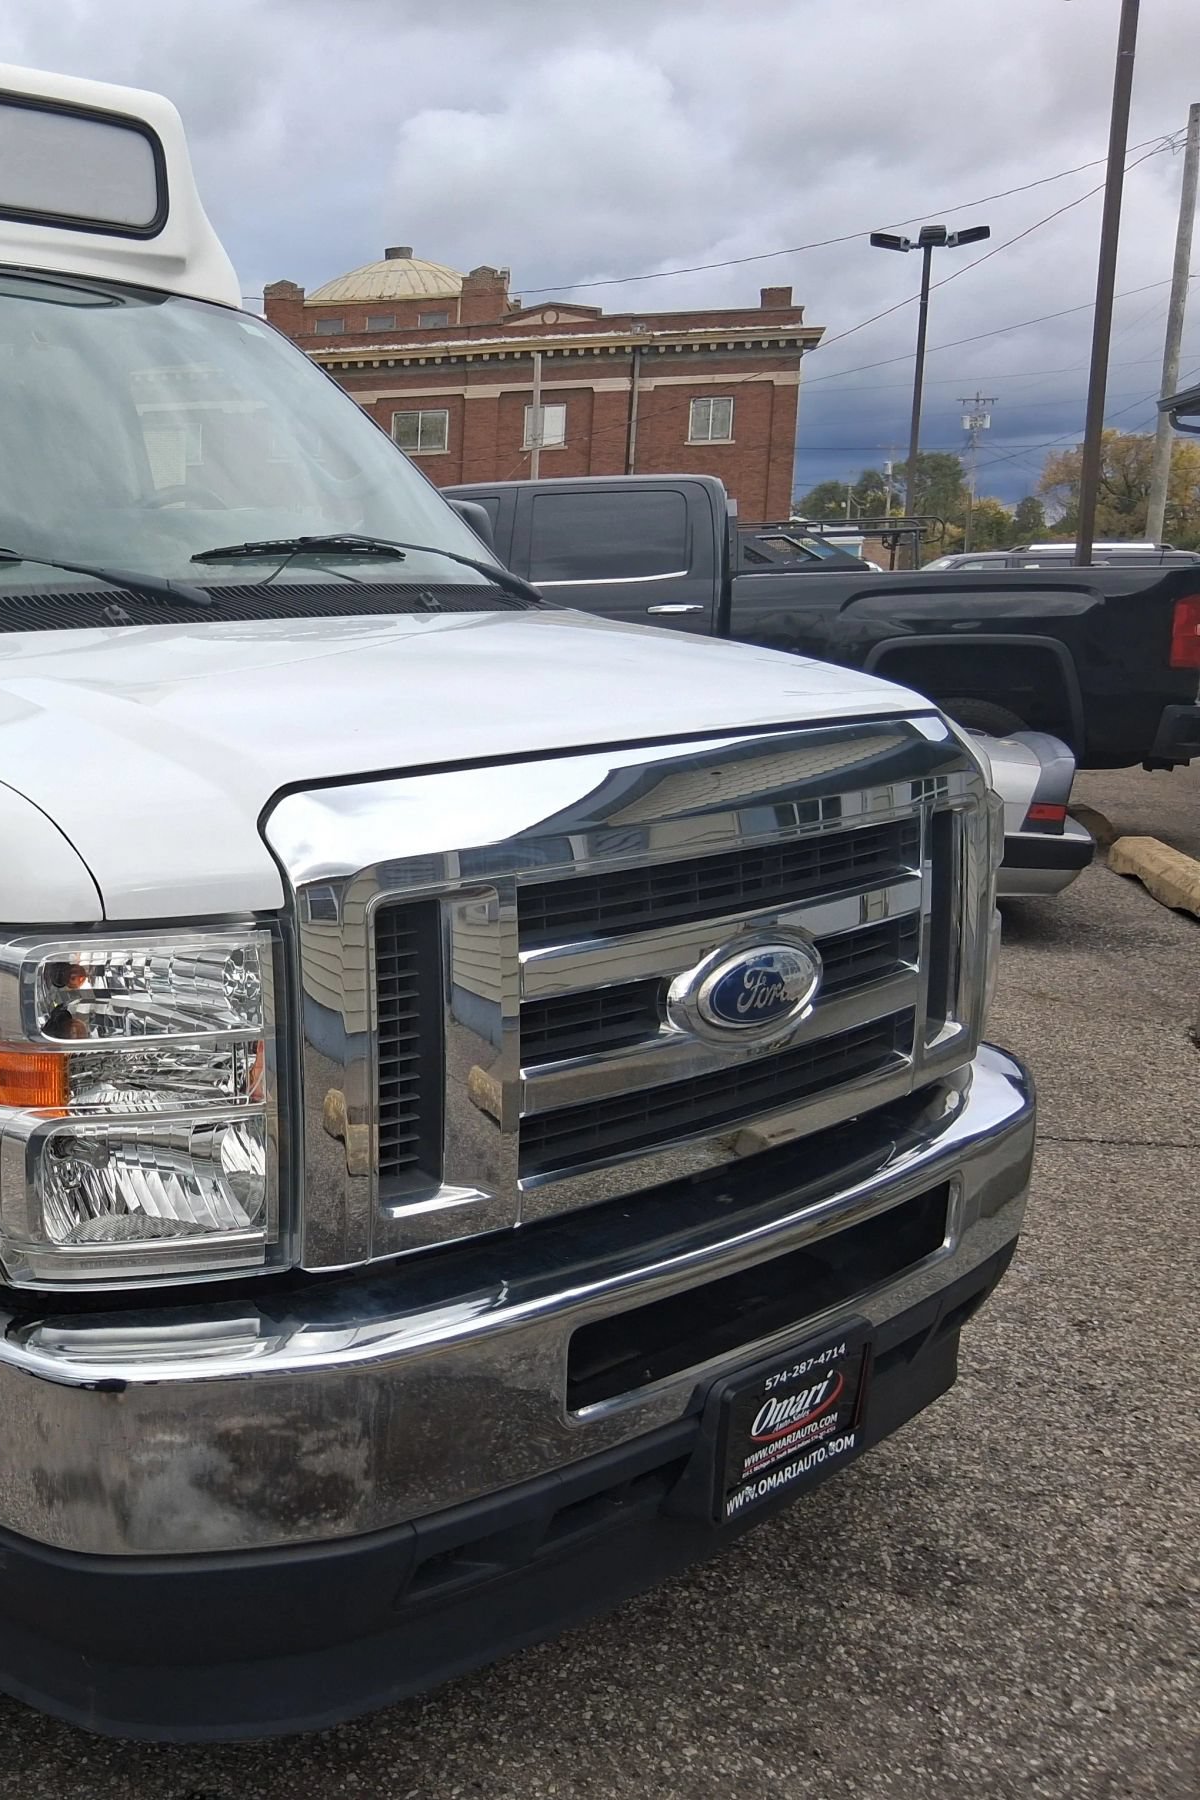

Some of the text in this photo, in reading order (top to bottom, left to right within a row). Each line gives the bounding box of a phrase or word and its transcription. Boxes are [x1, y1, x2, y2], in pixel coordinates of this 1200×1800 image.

[764, 1343, 847, 1391] 574-287-4714
[751, 1369, 834, 1437] Omari
[744, 1412, 839, 1468] WWW.OMARIAUTO.COM
